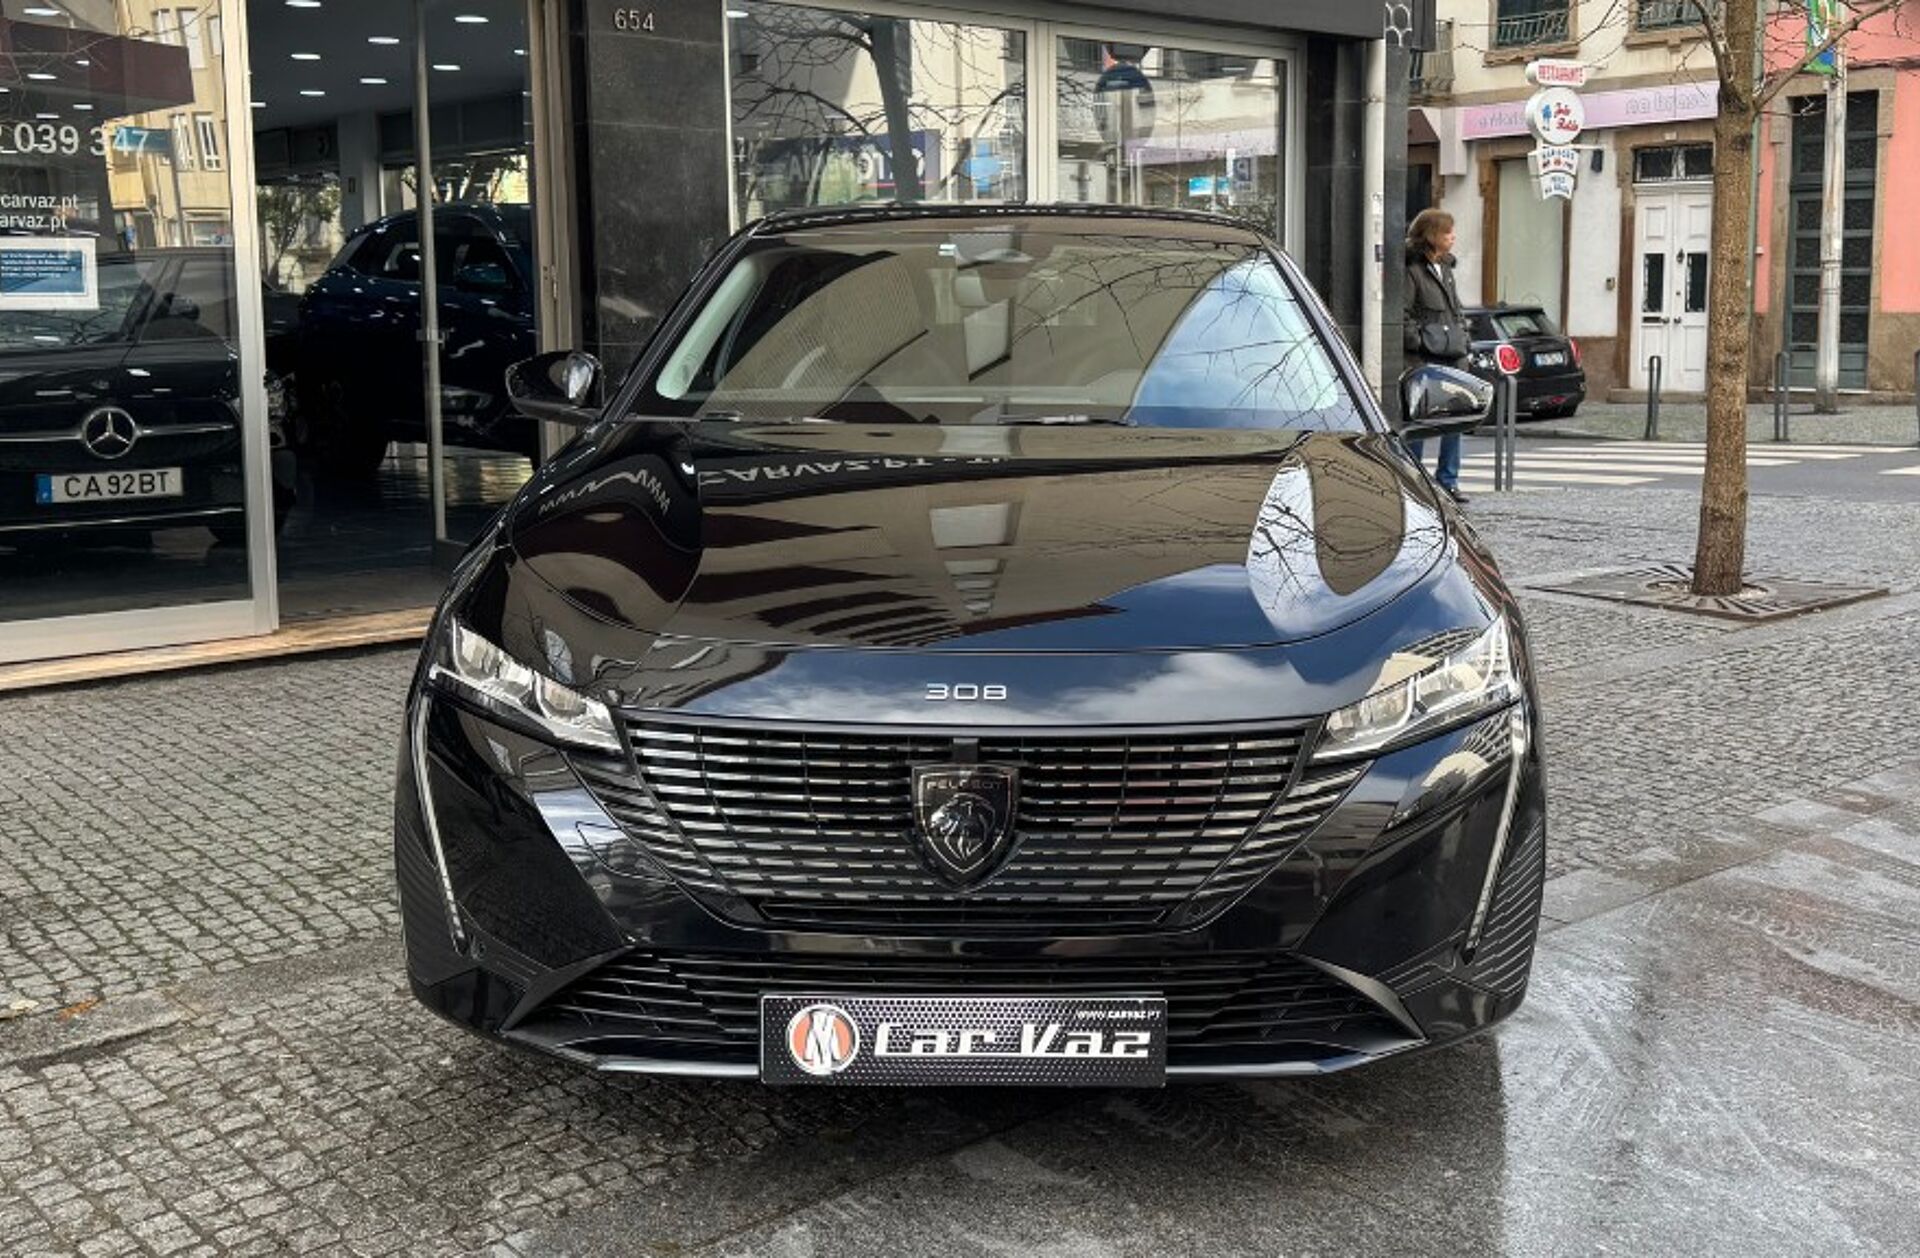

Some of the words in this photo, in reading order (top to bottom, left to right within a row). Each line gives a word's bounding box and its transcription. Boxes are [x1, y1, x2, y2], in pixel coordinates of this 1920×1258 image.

[614, 8, 655, 31] 654
[13, 122, 80, 155] 039
[925, 683, 1007, 700] 308
[874, 1022, 1000, 1059] Car
[1018, 1022, 1151, 1059] Vaz
